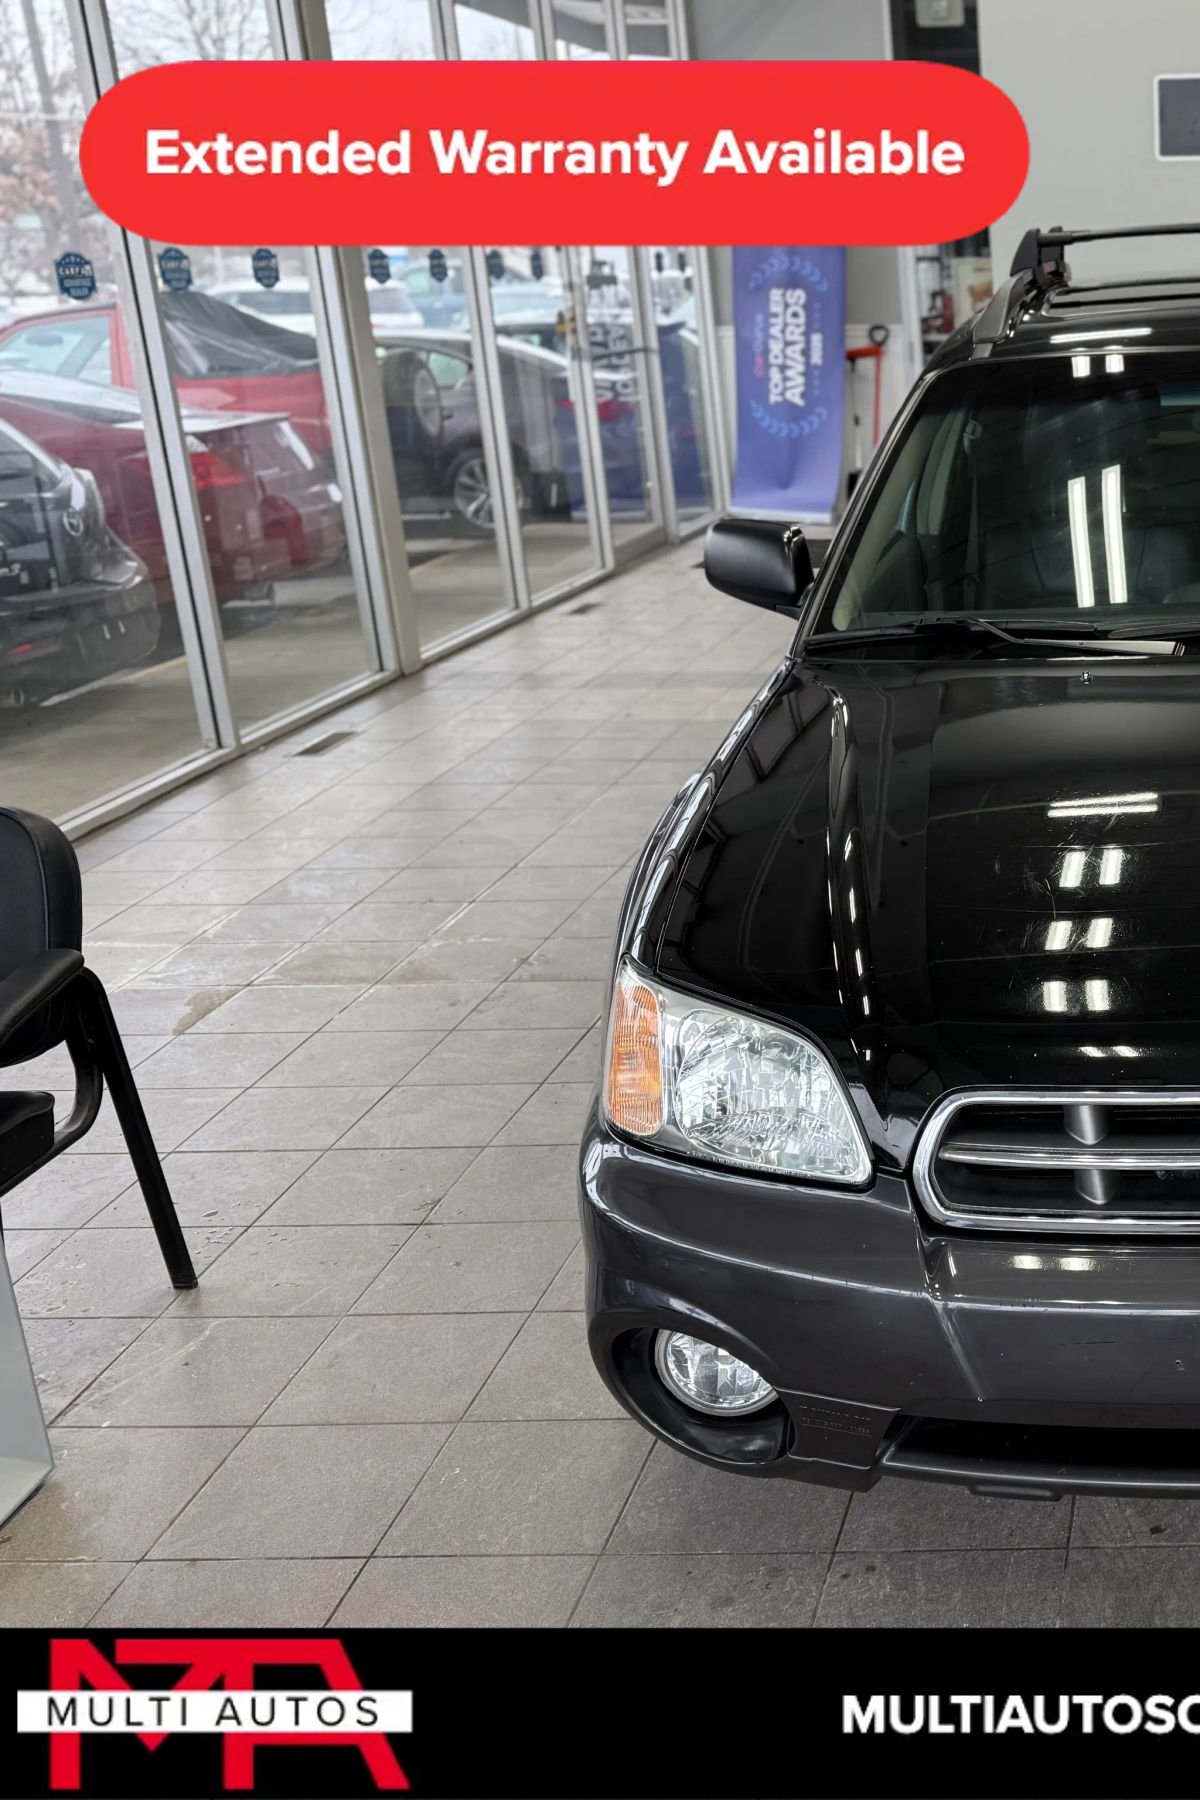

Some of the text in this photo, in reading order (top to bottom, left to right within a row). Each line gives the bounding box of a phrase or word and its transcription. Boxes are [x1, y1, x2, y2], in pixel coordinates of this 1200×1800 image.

[768, 287, 784, 405] TOP DEALER
[784, 288, 806, 407] AWARDS
